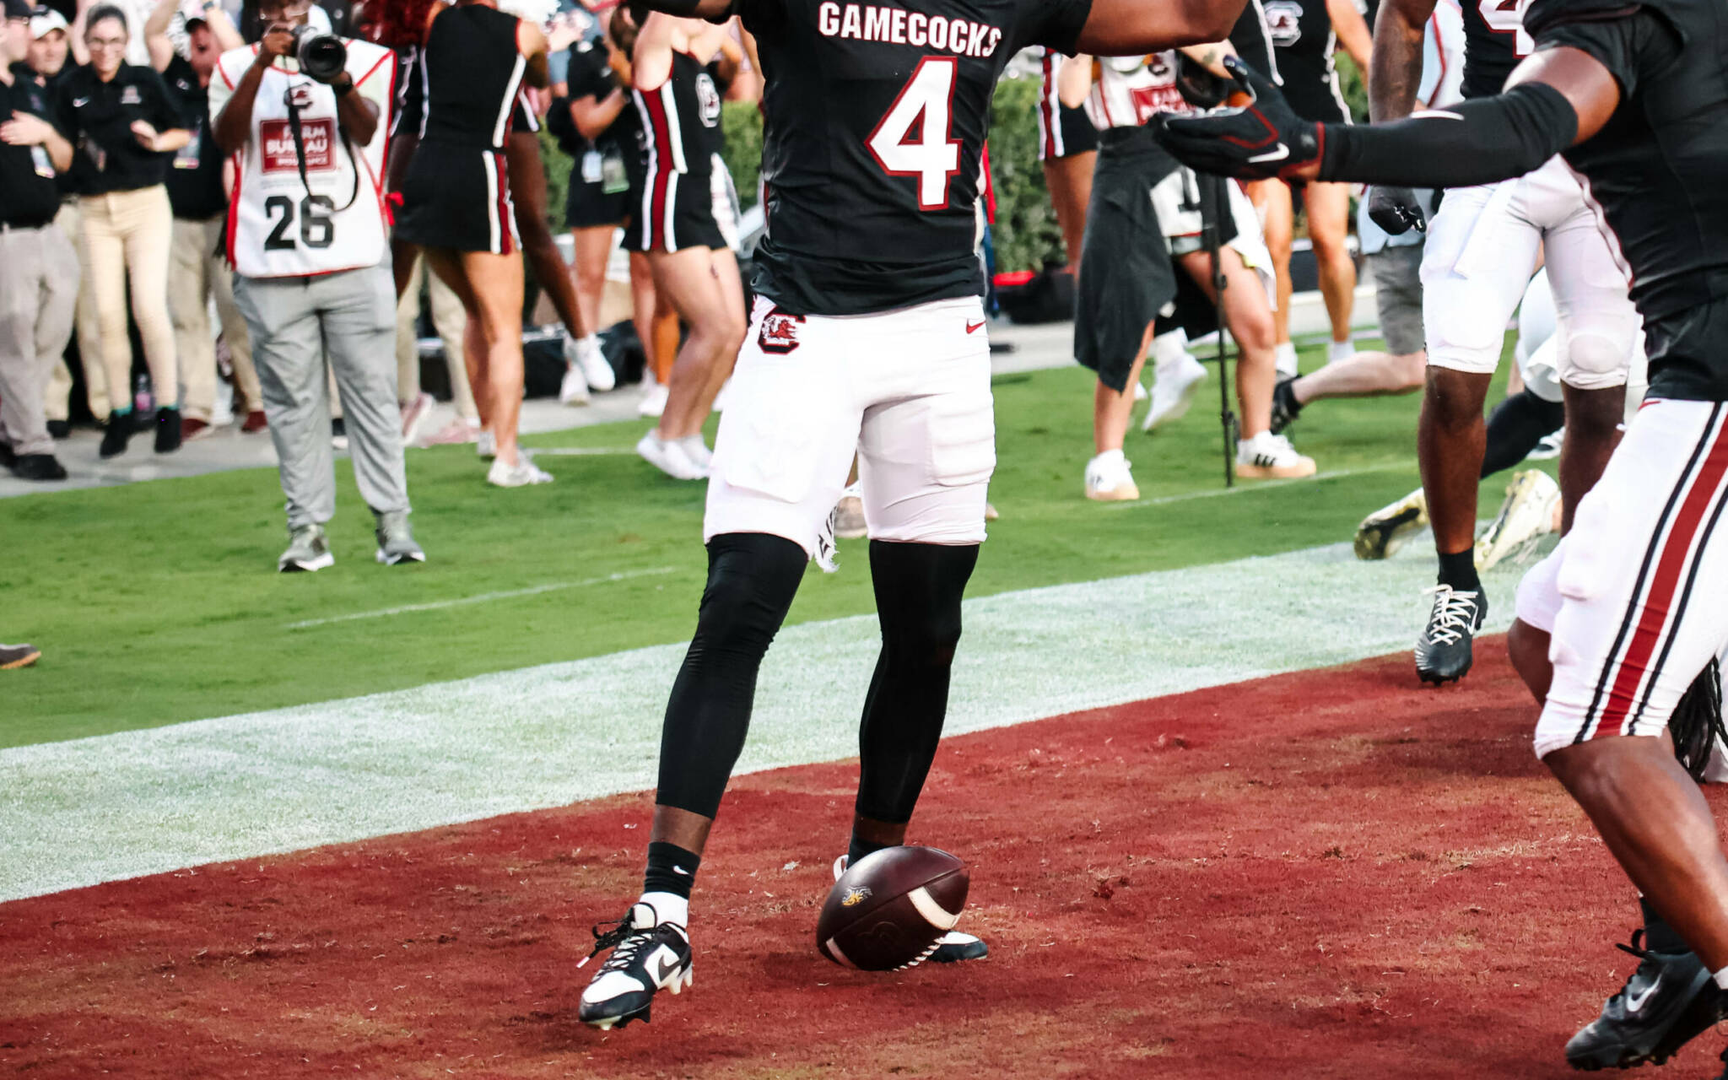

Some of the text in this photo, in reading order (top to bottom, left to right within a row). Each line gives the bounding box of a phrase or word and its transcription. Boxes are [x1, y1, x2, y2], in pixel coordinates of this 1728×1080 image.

[818, 0, 1002, 58] GAMECOCKS
[863, 54, 964, 212] 4
[264, 194, 335, 251] 26
